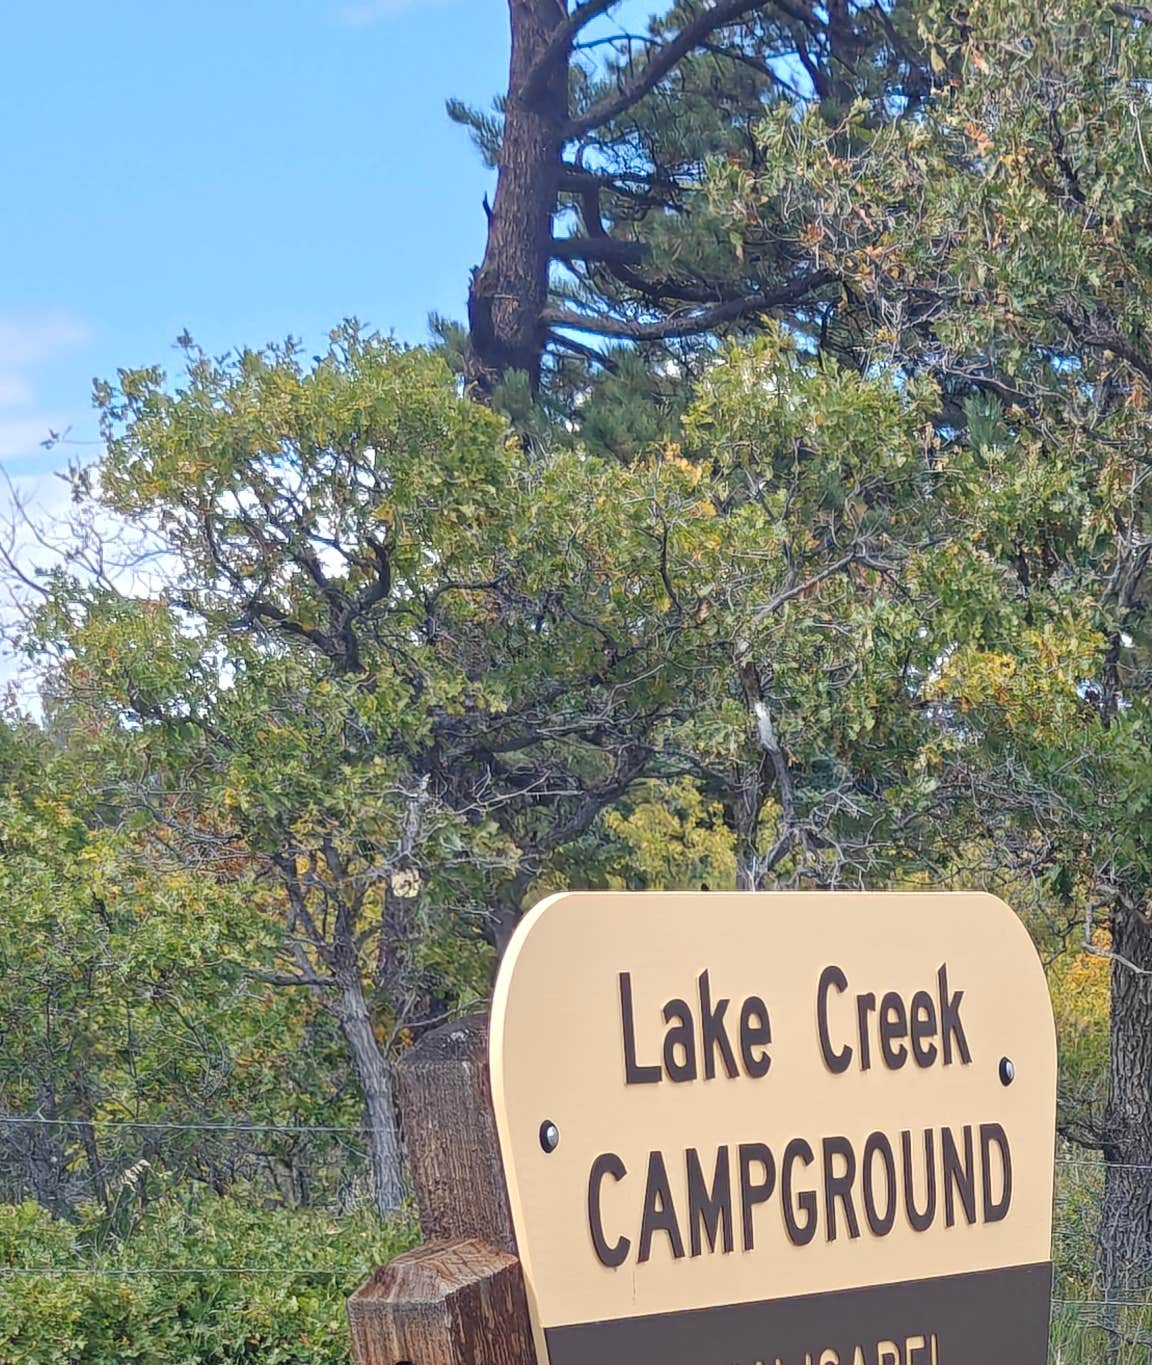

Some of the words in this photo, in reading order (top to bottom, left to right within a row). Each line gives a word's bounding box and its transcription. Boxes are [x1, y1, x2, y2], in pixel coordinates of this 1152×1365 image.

[619, 969, 772, 1085] Lake
[817, 962, 972, 1074] Creek
[588, 1122, 1012, 1268] CAMPGROUND
